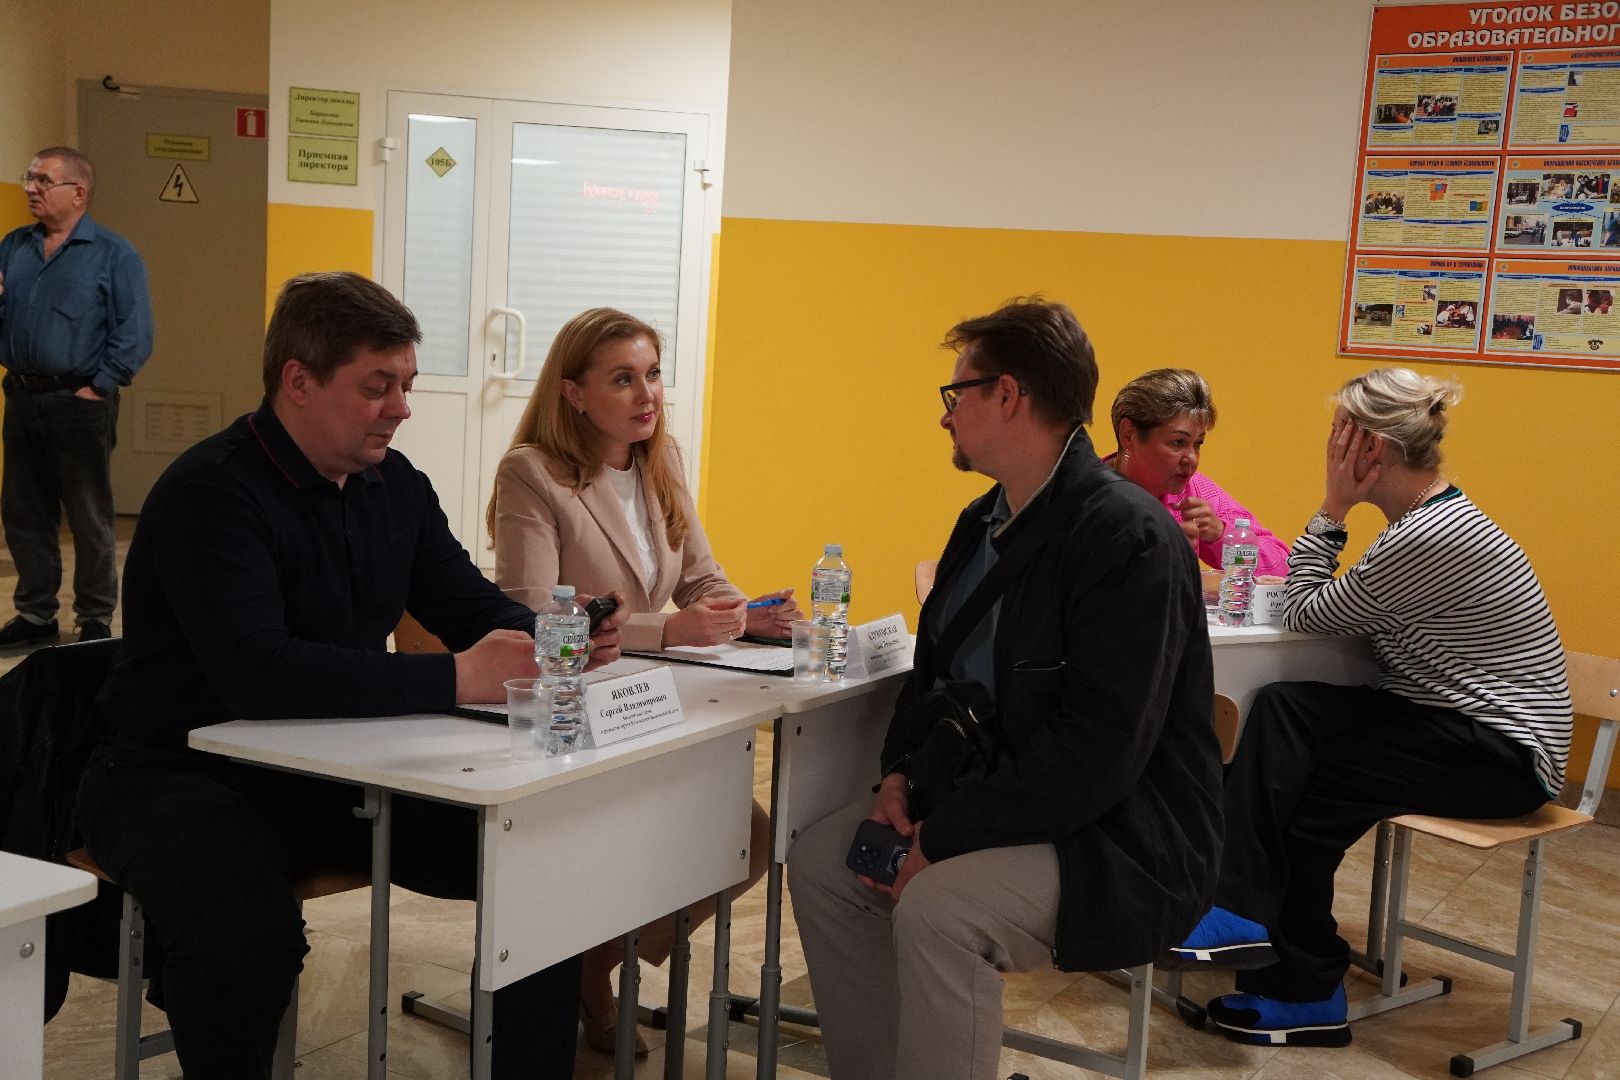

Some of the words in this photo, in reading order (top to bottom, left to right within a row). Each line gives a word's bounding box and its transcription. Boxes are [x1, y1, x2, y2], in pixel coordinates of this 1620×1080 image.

[1469, 5, 1554, 25] УГОЛОК
[1560, 1, 1620, 20] БЕЗО
[1408, 24, 1620, 48] ОБРАЗОВАТЕЛЬНОГ
[295, 94, 329, 103] Директор
[298, 149, 348, 161] Приемная
[431, 158, 451, 167] 105Б
[297, 161, 348, 172] директора
[611, 682, 650, 701] ЯКОВЛЕВ
[600, 707, 623, 719] Сергей
[623, 694, 667, 712] Владимирович
